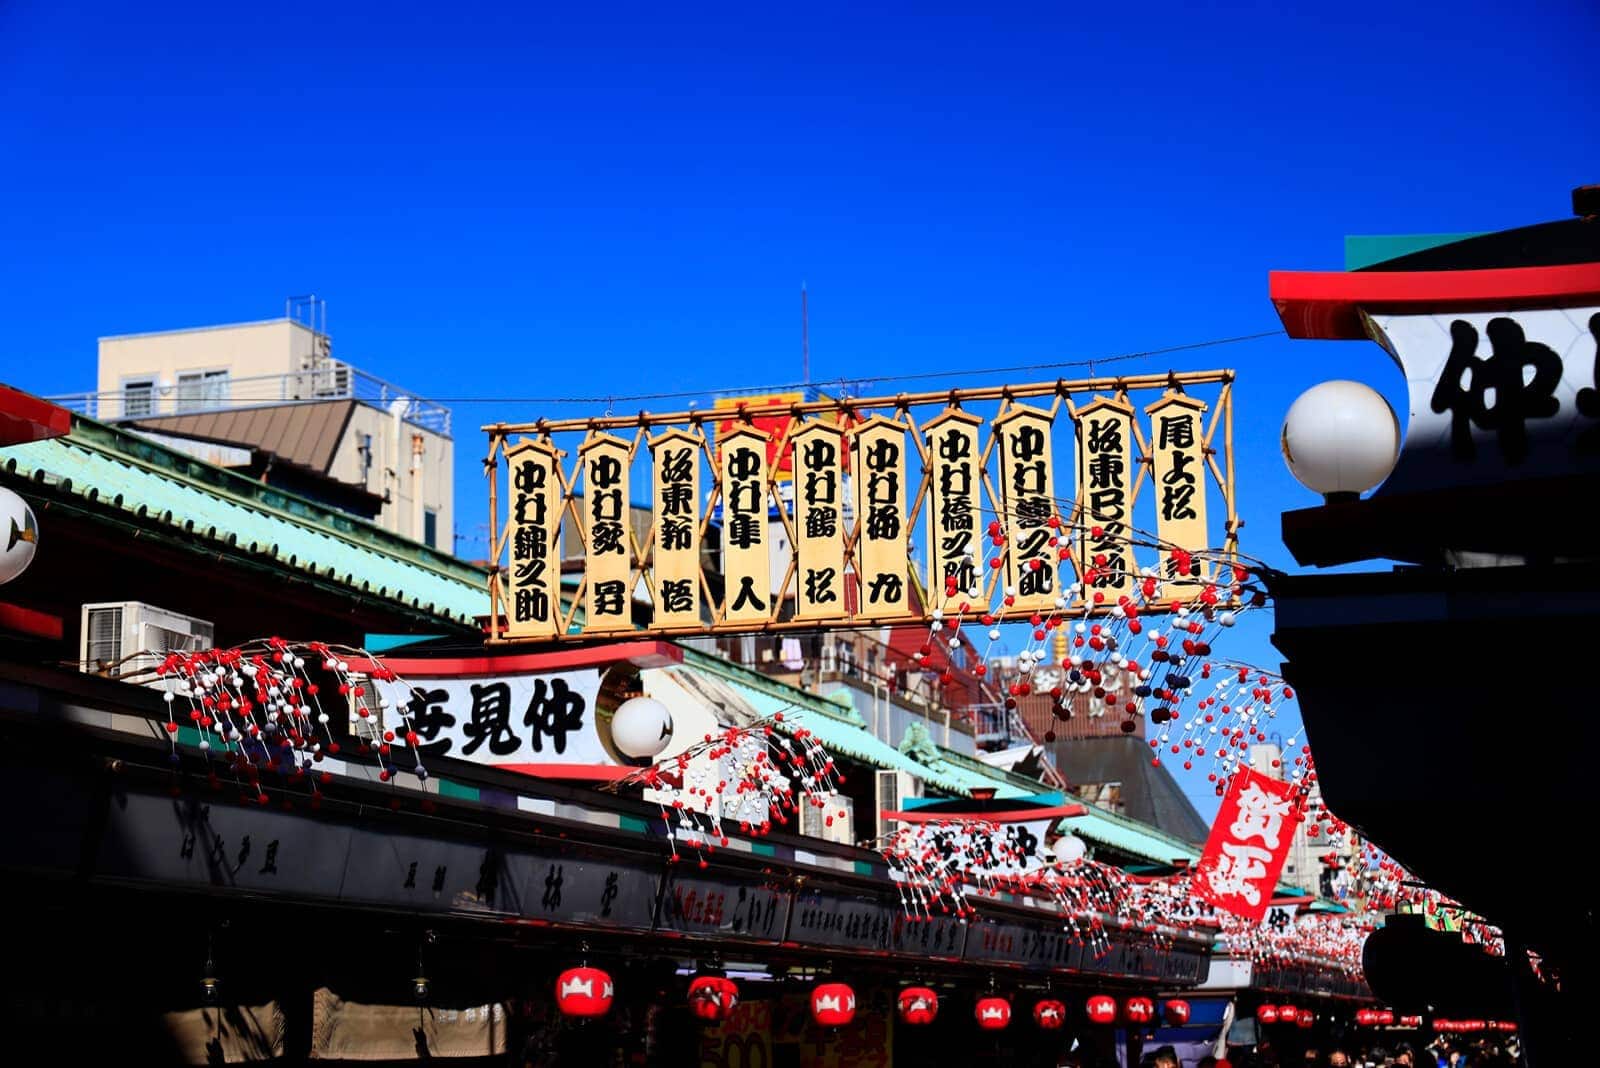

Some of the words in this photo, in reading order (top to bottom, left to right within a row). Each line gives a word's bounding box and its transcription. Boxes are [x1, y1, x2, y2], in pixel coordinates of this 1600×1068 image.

[1431, 316, 1600, 466] 仲
[728, 447, 766, 612] 中村隼人
